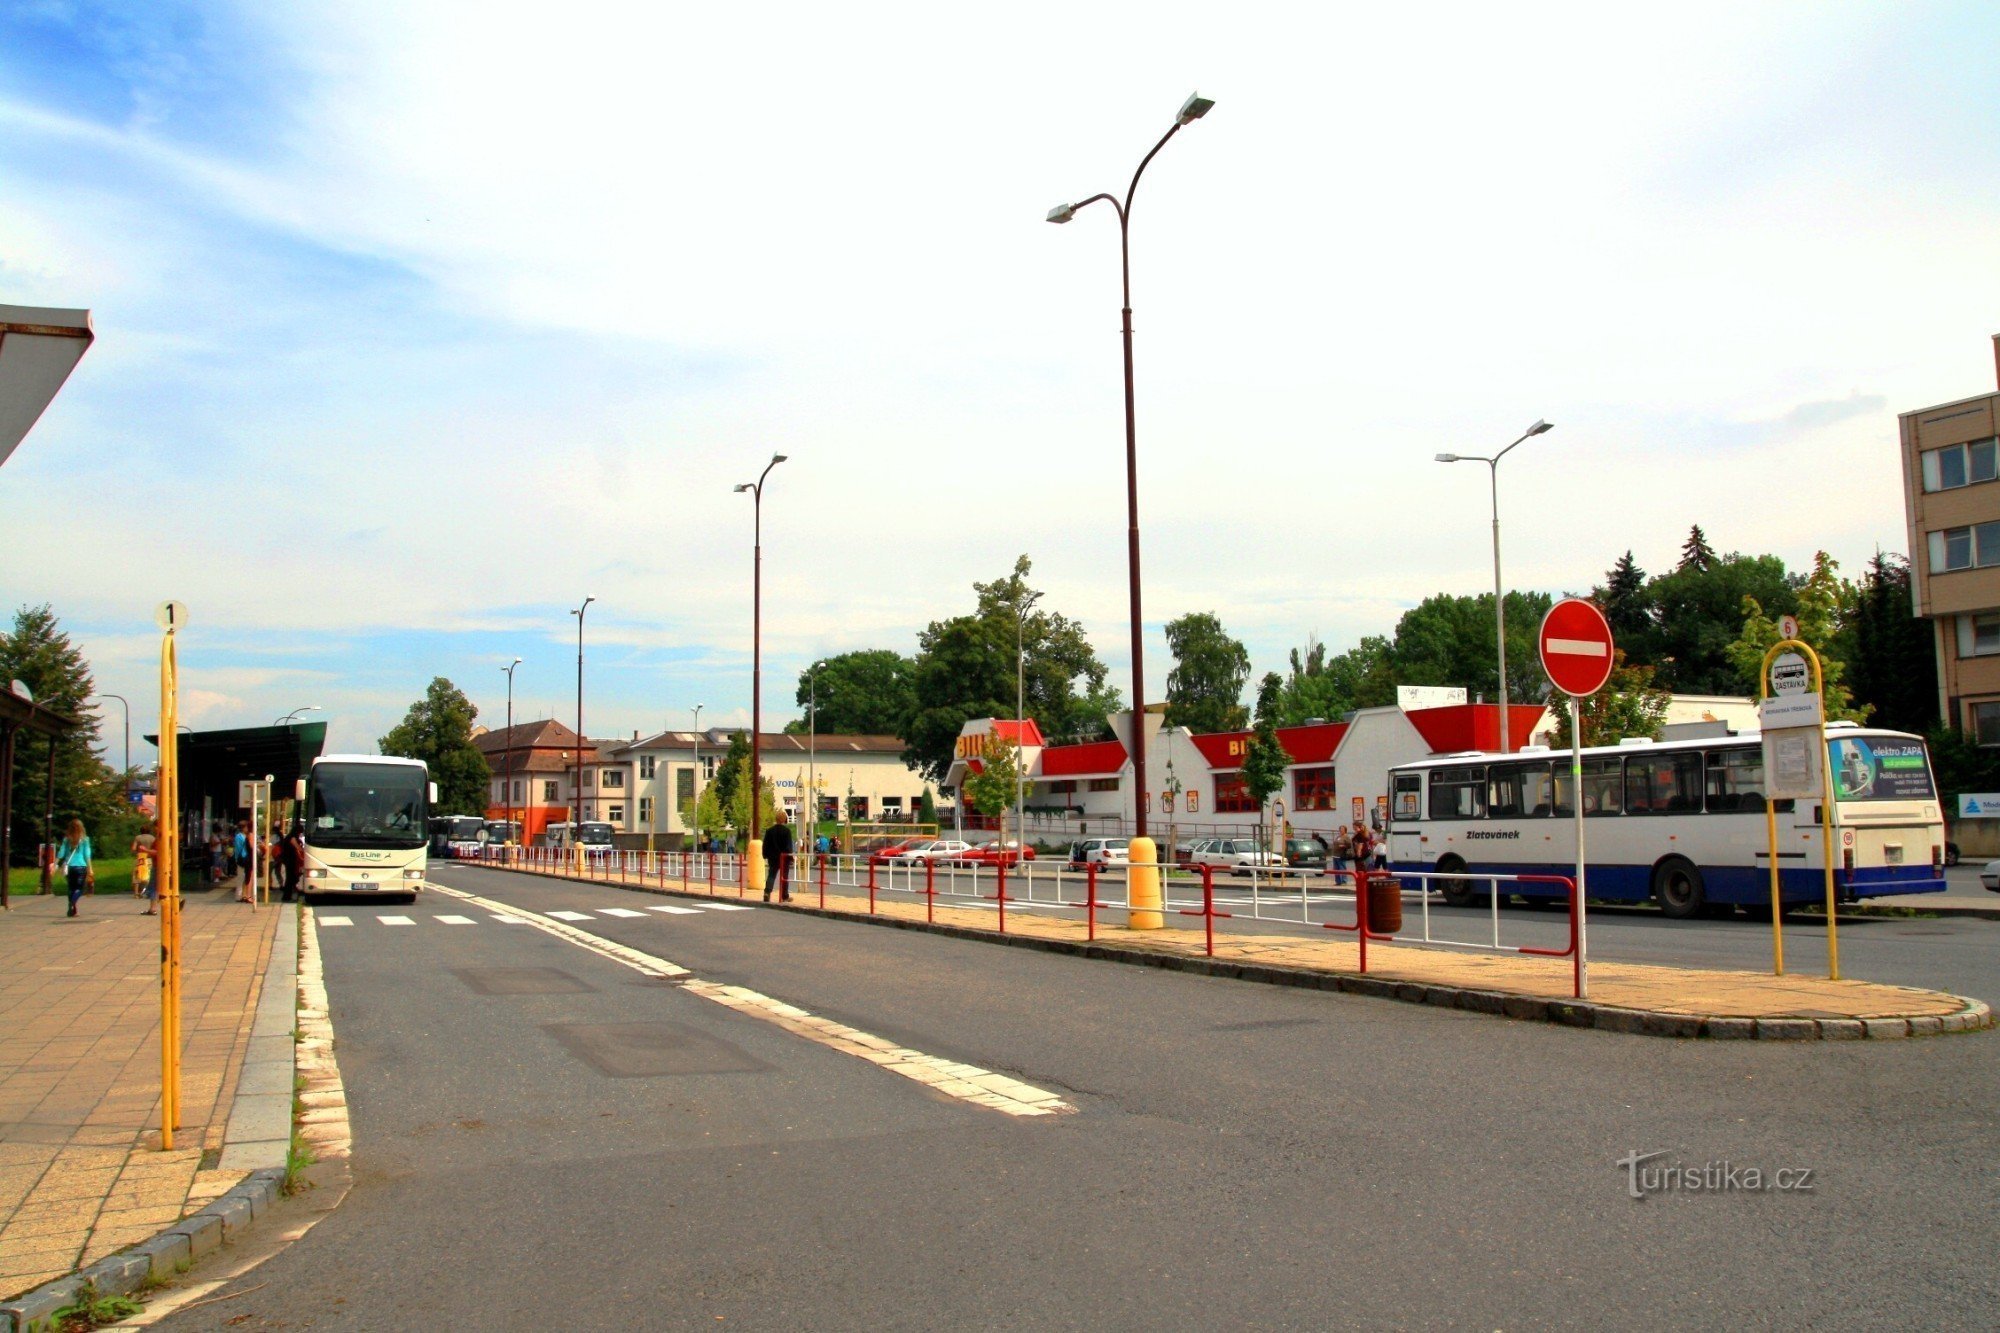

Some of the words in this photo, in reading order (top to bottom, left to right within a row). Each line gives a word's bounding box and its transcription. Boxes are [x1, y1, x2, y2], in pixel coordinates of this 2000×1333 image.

[166, 603, 174, 624] 1
[1784, 621, 1792, 635] 6
[1873, 747, 1900, 756] elektro
[1902, 746, 1922, 756] ZAPA
[1466, 829, 1520, 840] Zlatovánek
